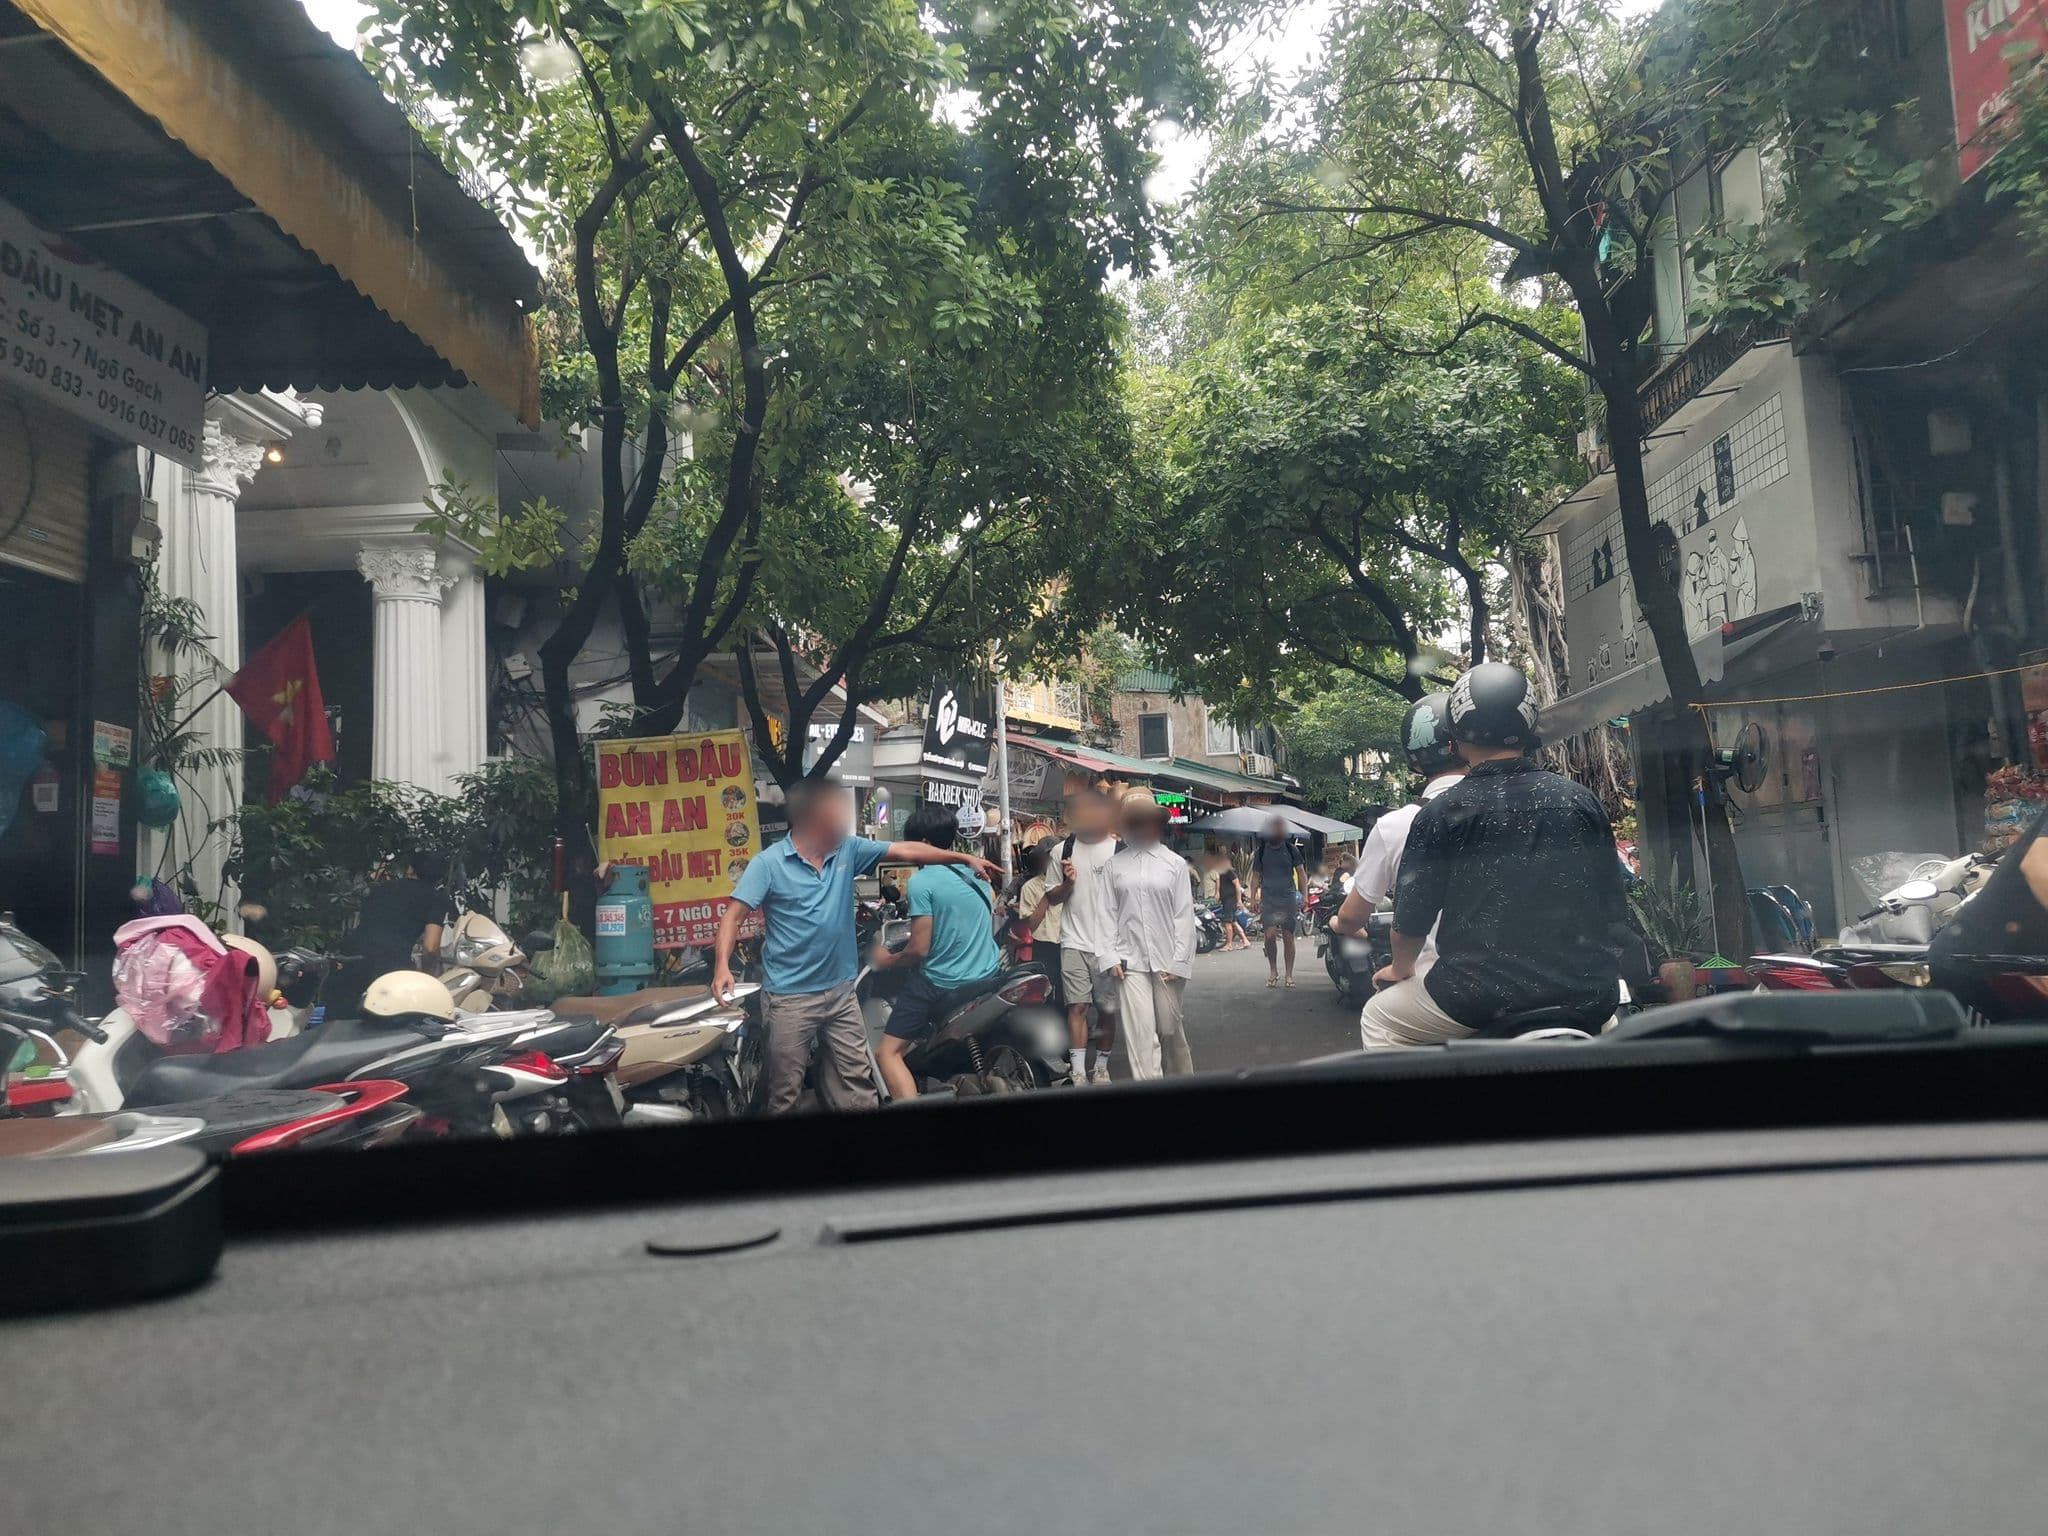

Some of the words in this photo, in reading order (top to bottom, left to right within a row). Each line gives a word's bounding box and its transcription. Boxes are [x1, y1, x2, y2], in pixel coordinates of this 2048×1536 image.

[17, 309, 43, 339] Số
[45, 325, 56, 348] 3
[72, 338, 81, 359] 7
[123, 366, 163, 403] Gạch
[128, 320, 164, 363] AN
[168, 345, 201, 383] AN
[14, 346, 47, 379] 930
[51, 365, 82, 397] 833
[98, 388, 135, 424] 0916
[140, 410, 165, 439] 037
[169, 425, 196, 455] 085
[600, 745, 668, 789] BÚN
[676, 739, 742, 787] ĐẬU
[605, 801, 652, 839] AN
[661, 795, 708, 834] AN
[726, 812, 745, 821] 30K
[687, 848, 722, 882] MẸT
[729, 847, 749, 857] 35K
[664, 909, 674, 924] 7
